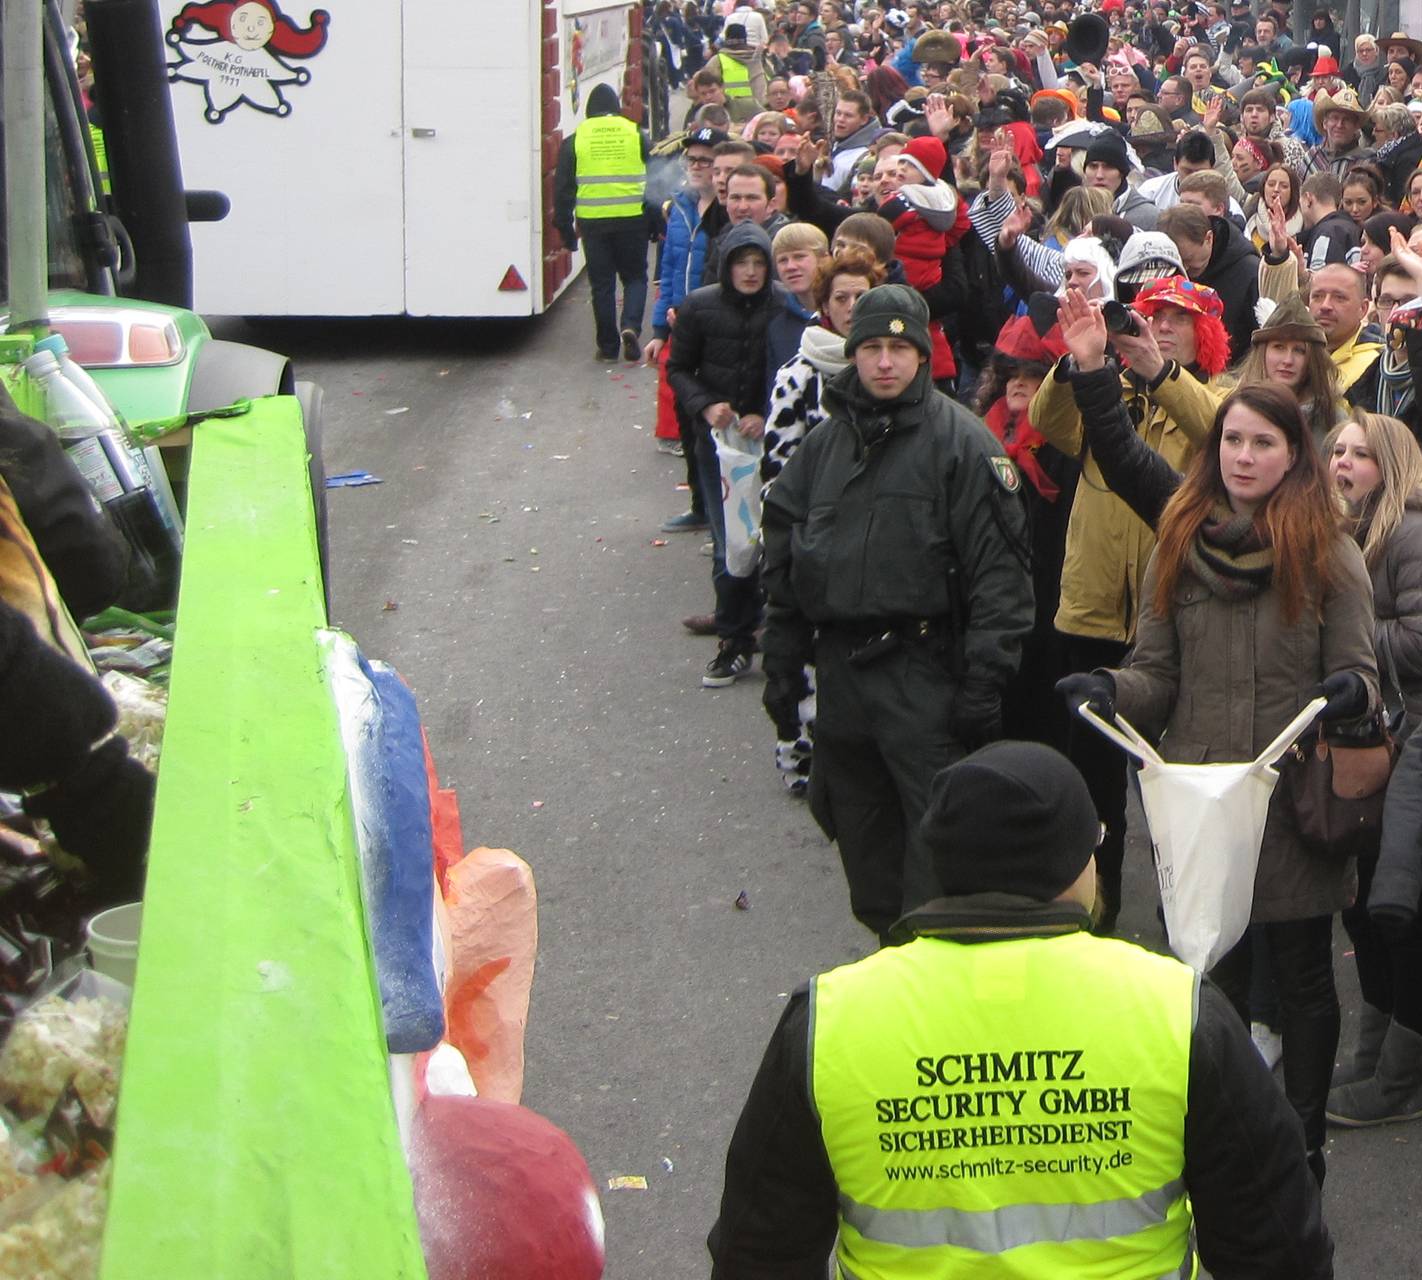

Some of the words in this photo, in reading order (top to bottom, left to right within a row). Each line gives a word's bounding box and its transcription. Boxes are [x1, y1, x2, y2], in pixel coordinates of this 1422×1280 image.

[916, 1050, 1085, 1087] SCHMITZ
[876, 1090, 1027, 1123] SECURITY
[1039, 1087, 1131, 1115] GMBH
[879, 1120, 1133, 1152] SICHERHEITSDIENST
[885, 1150, 1133, 1181] www.schmitz-security.de
